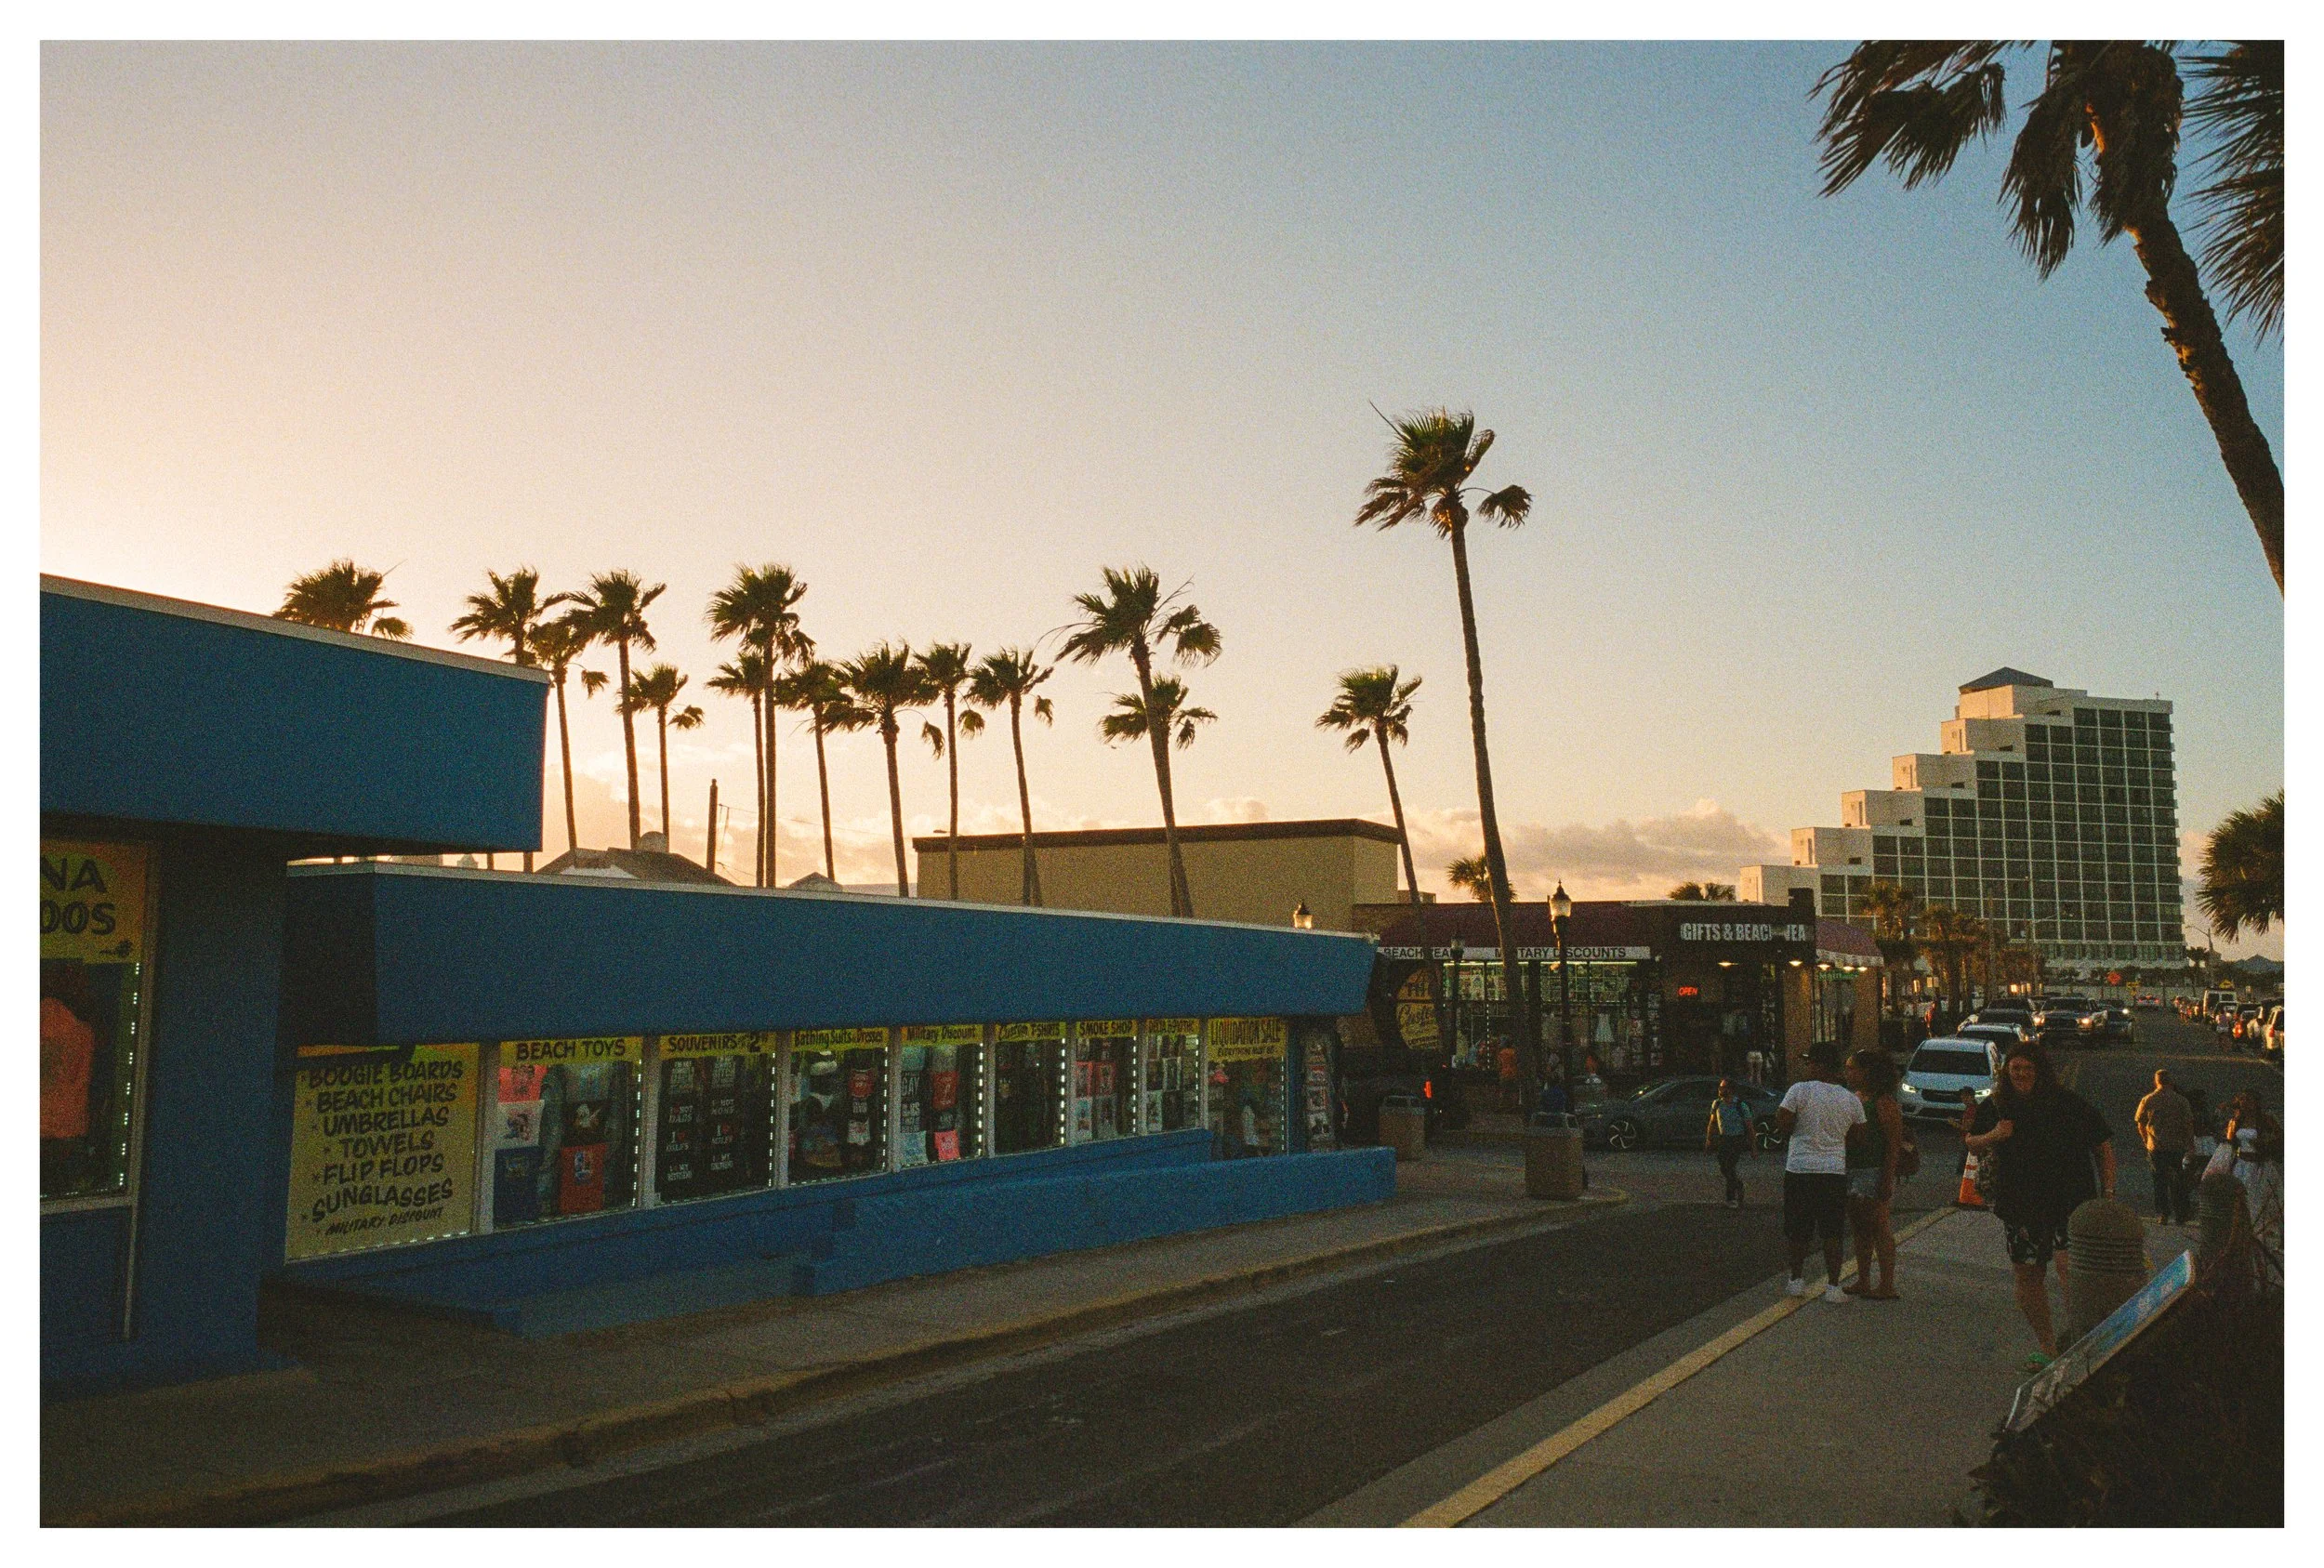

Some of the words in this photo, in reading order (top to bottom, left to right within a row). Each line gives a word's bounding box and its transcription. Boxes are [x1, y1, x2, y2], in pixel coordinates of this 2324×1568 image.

[1681, 923, 1721, 941] GIFTS
[1722, 923, 1733, 941] &
[1384, 948, 1423, 958] BEACH
[1495, 948, 1551, 958] MTARY
[1553, 948, 1626, 958] DSCOUNTS
[1677, 985, 1698, 997] OPEN
[795, 1029, 828, 1048] Bathing
[830, 1028, 852, 1044] Suits
[1079, 1021, 1108, 1035] SMOKE
[1111, 1021, 1132, 1034] SHOP
[1211, 1020, 1260, 1046] LIQUIDATION
[1261, 1019, 1281, 1043] SALE
[517, 1040, 576, 1061] BEACH
[582, 1038, 626, 1058] TOYS
[668, 1034, 737, 1052] SOUVENIRS
[309, 1062, 384, 1088] BOOGIE
[390, 1061, 463, 1084] BOARDS
[902, 1076, 919, 1097] GAY
[317, 1087, 384, 1113] BEACH
[389, 1083, 457, 1107] CHAIRS
[324, 1107, 450, 1137] UMBRELLAS
[338, 1130, 435, 1159] TOWELS
[324, 1160, 375, 1185] FLIP
[379, 1153, 444, 1179] FLOPS
[311, 1178, 454, 1223] SUNGLASSES
[325, 1215, 385, 1235] MILITARY
[389, 1206, 444, 1226] DISCOUNT
